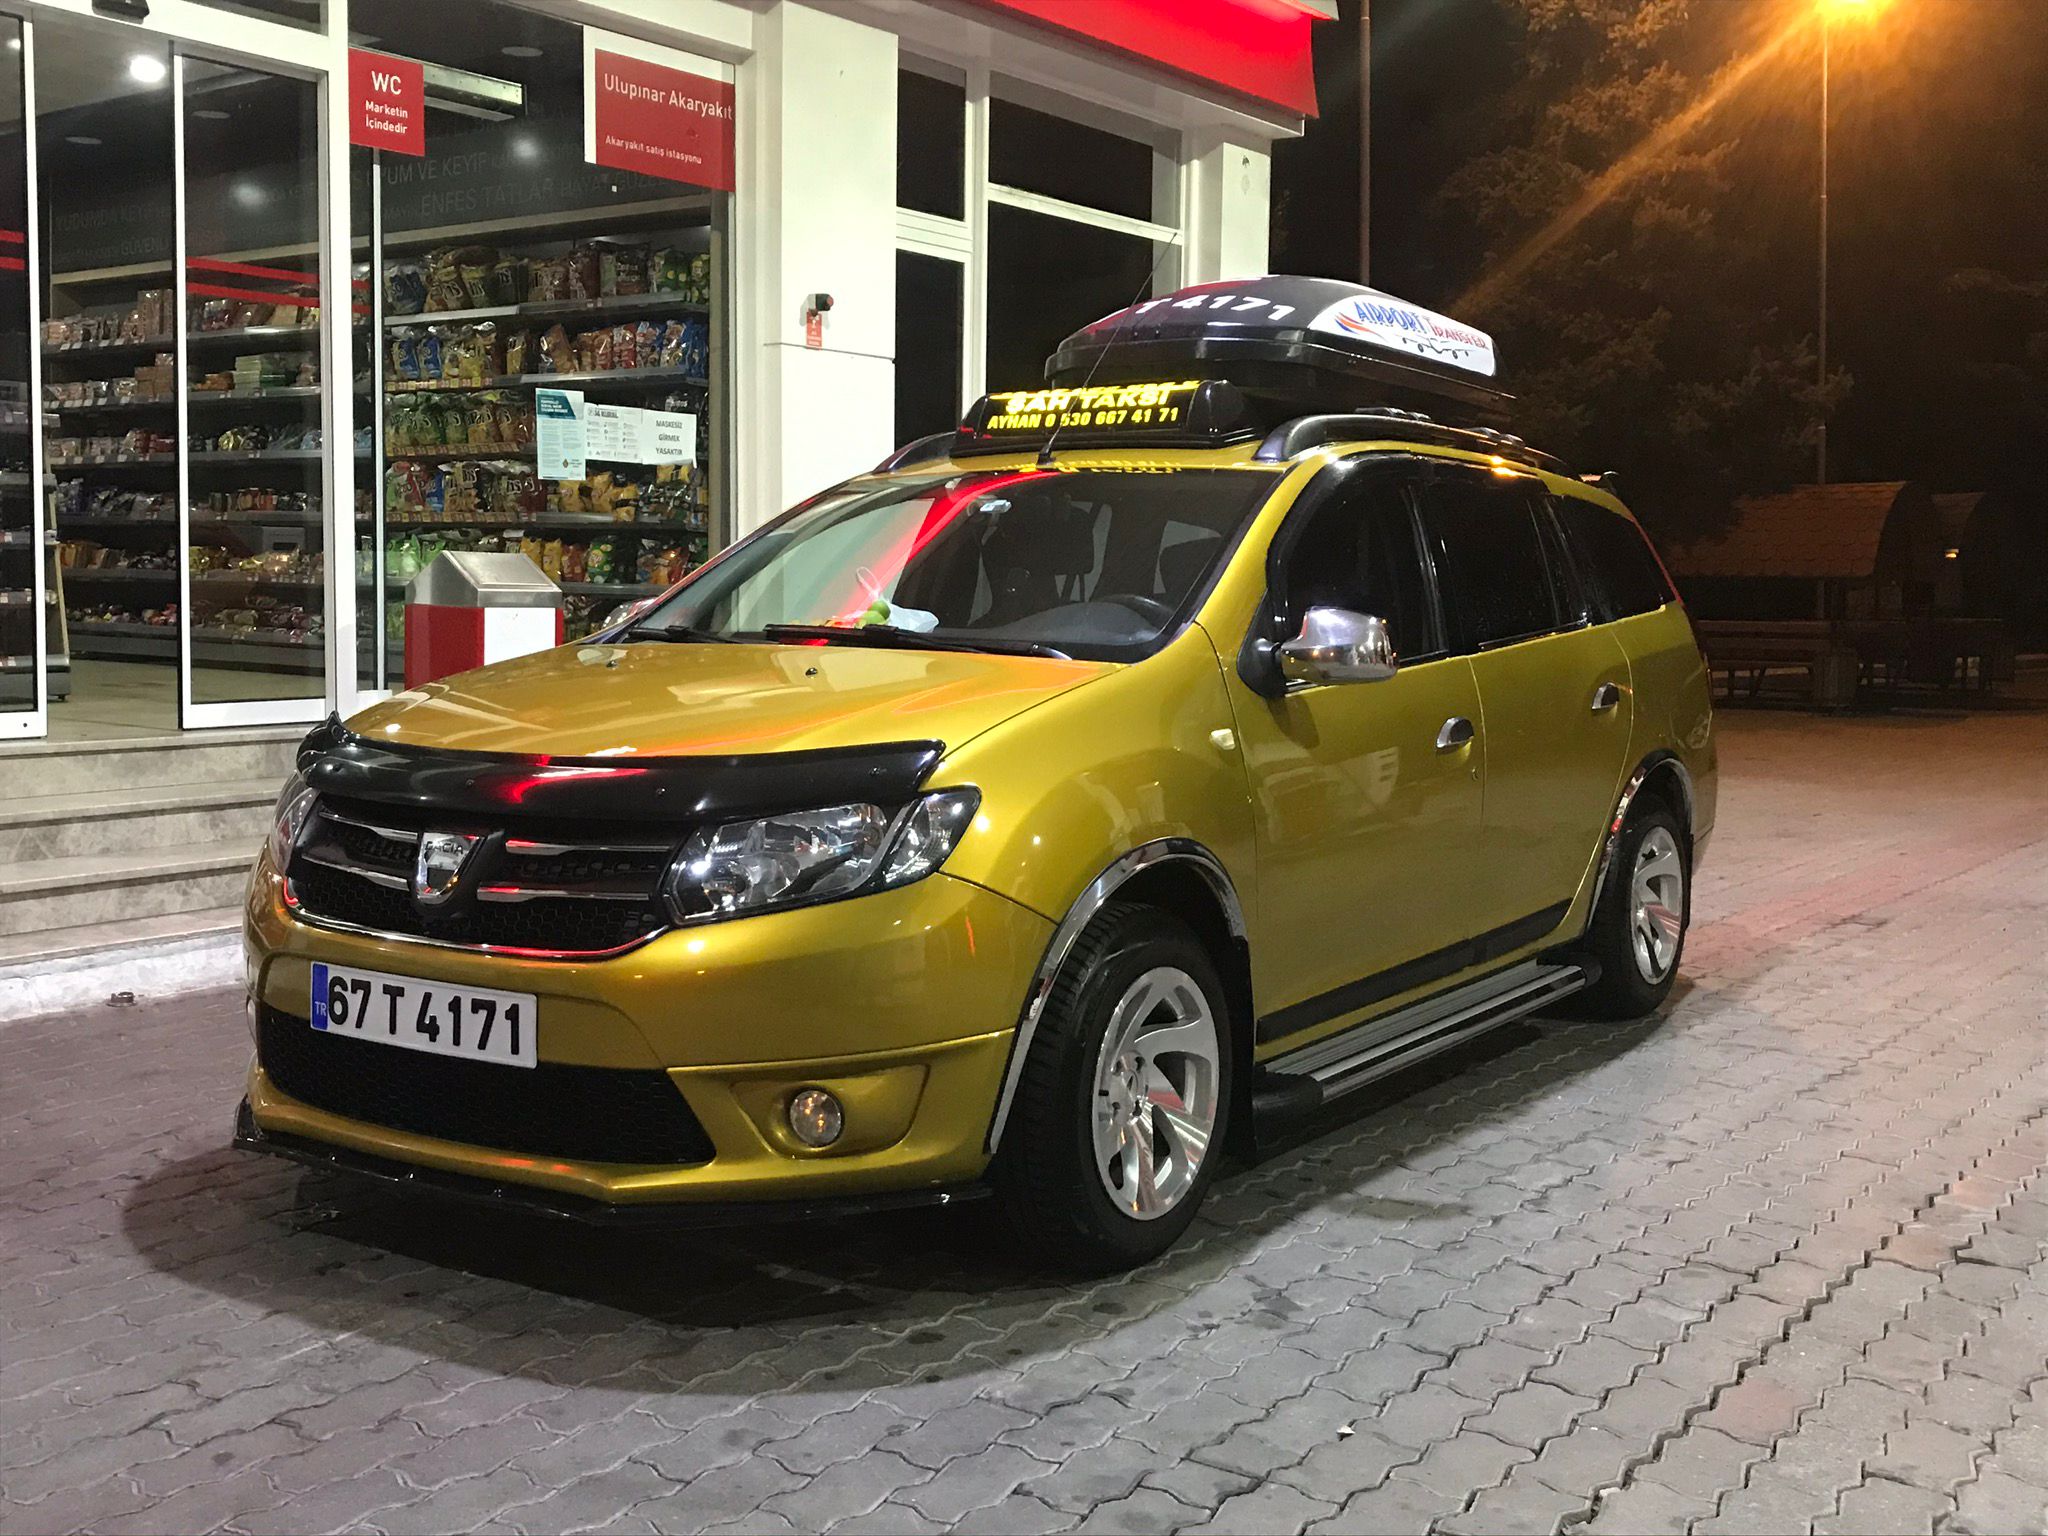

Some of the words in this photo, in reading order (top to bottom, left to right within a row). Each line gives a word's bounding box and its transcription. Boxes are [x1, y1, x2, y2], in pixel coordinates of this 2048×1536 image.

[371, 70, 402, 95] WC
[365, 100, 408, 119] Marketin
[604, 73, 666, 103] Ulupınar
[668, 90, 732, 120] Akaryakıt
[365, 114, 408, 134] İçindedir
[605, 135, 644, 152] Akaryakıt
[646, 144, 665, 157] satış
[665, 147, 702, 165] istasyonu
[417, 159, 437, 181] VE
[421, 187, 478, 217] ENFES
[1172, 294, 1296, 321] 4171
[1353, 301, 1427, 335] AIRPORT
[987, 414, 1041, 430] AYHAN
[1044, 413, 1056, 428] 0
[1060, 412, 1091, 427] 530
[1095, 410, 1127, 426] 667
[1131, 408, 1152, 424] 41
[1158, 407, 1179, 423] 71
[315, 1001, 327, 1017] TR
[328, 976, 371, 1029] 67
[382, 984, 405, 1035] T
[416, 991, 520, 1056] 4171
